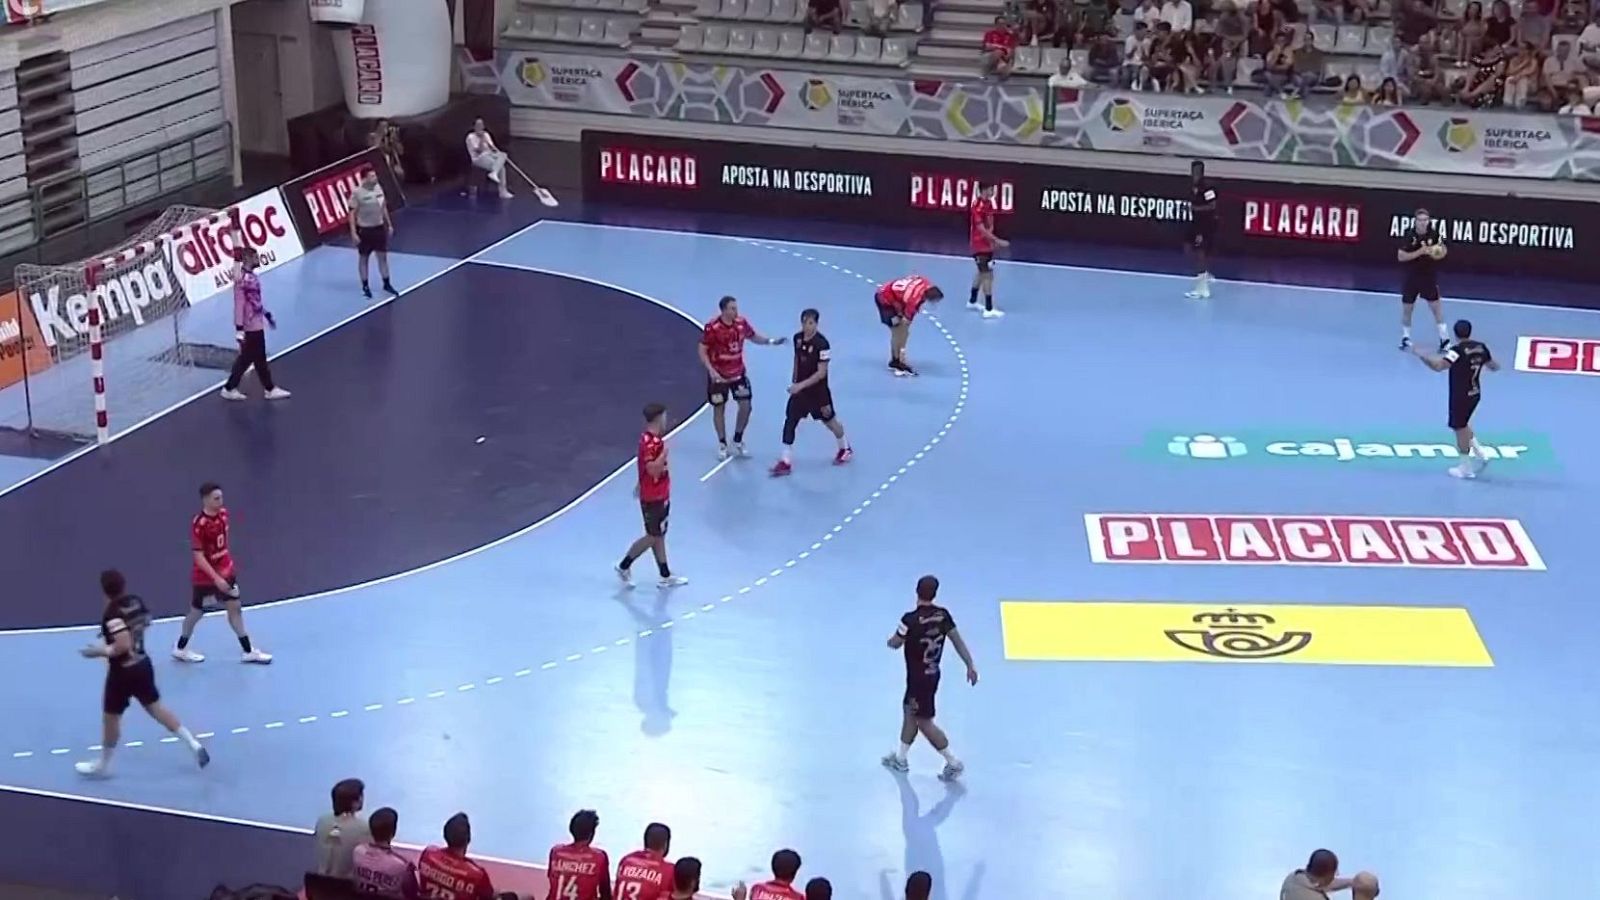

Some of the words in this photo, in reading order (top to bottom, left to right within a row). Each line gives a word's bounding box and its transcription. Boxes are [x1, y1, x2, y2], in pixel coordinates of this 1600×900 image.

[600, 151, 697, 185] PLACARD
[722, 165, 769, 188] APOSTA
[773, 169, 790, 190] NA
[794, 170, 873, 197] DESPORTIVA
[1041, 189, 1093, 213] APOSTA
[1097, 192, 1116, 215] NA
[1245, 201, 1360, 238] PLACARD
[1390, 215, 1448, 239] APTA
[1453, 219, 1474, 241] NA
[1478, 220, 1575, 249] DESPORTIVA
[30, 259, 173, 347] Kempa
[1105, 518, 1522, 564] PLACARD
